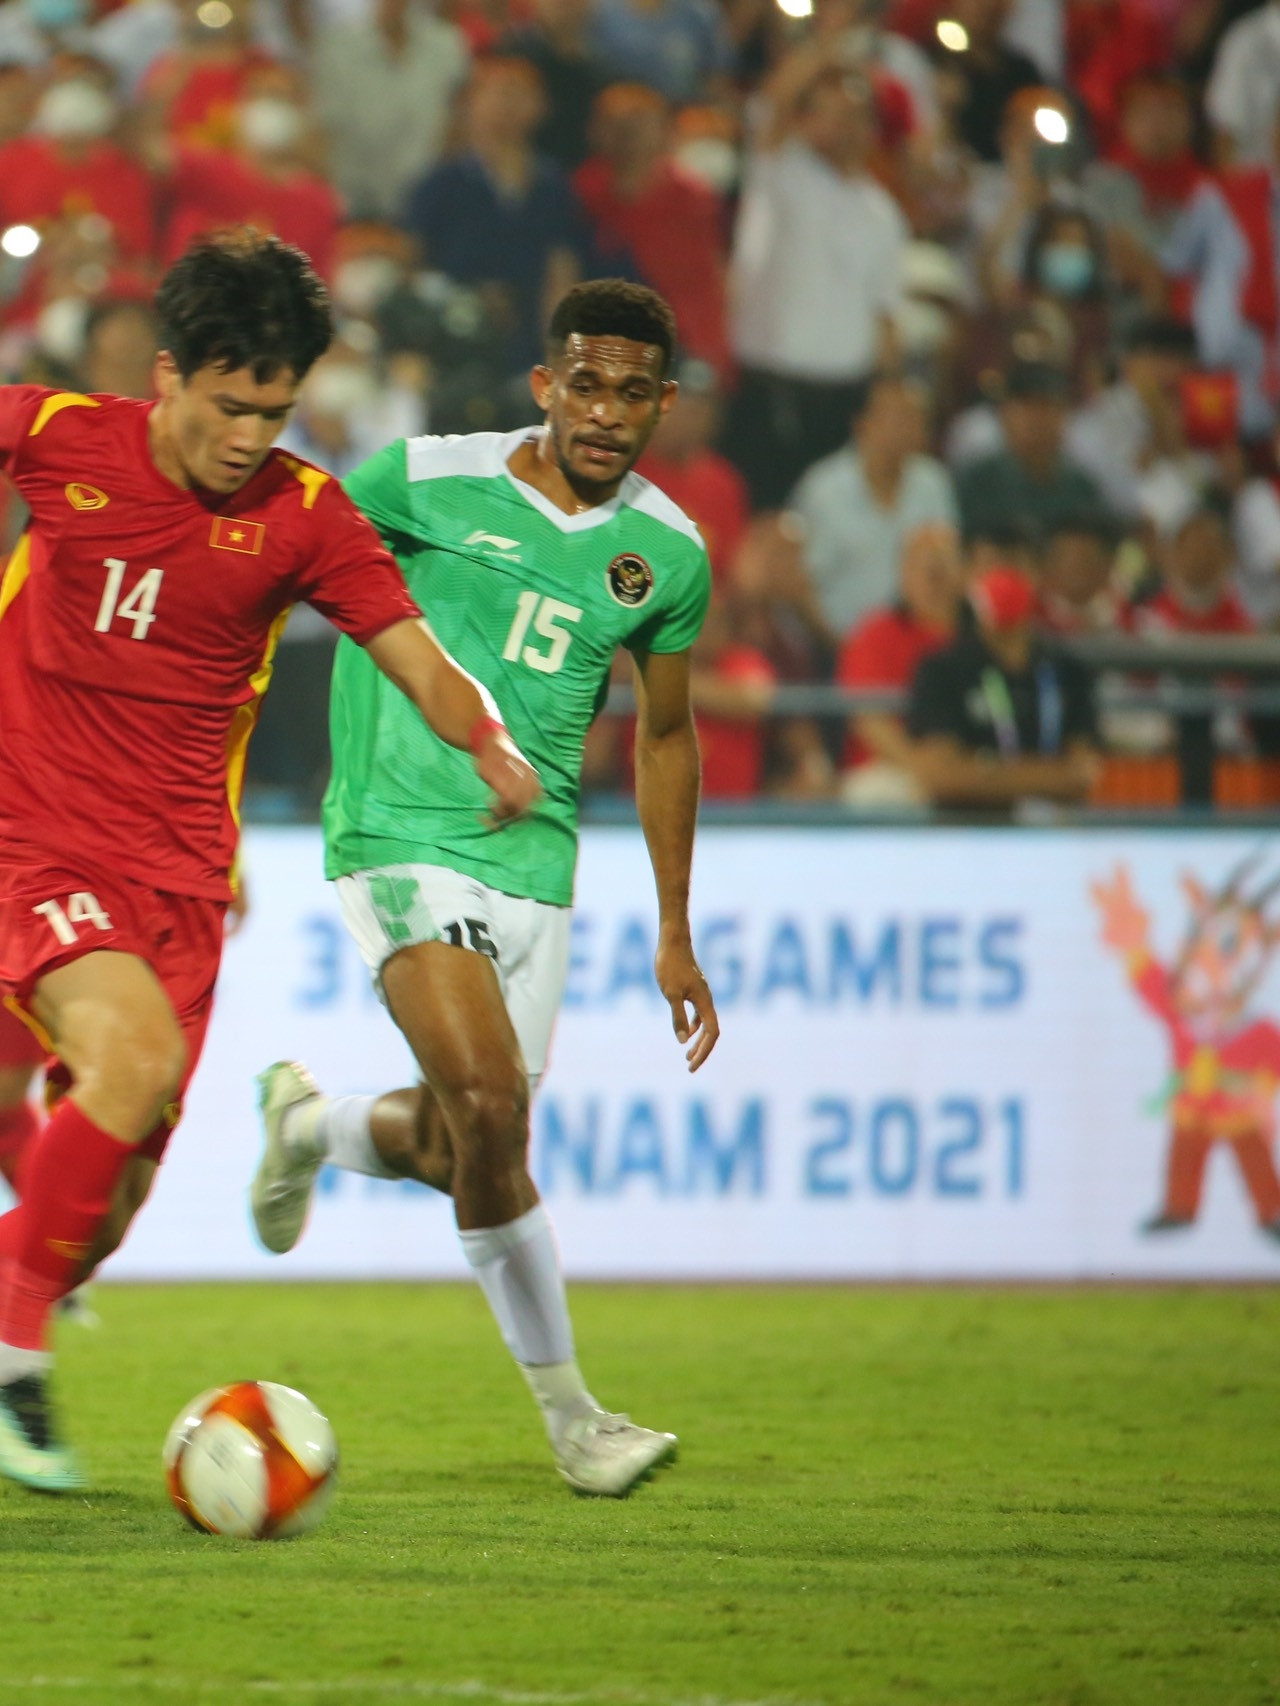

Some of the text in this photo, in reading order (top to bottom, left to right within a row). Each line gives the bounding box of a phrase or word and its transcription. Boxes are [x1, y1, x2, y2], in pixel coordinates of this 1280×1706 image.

[94, 557, 164, 640] 14
[502, 590, 584, 674] 15
[32, 892, 114, 945] 14
[443, 917, 499, 961] 15
[696, 914, 1032, 1012] GAMES
[804, 1096, 1032, 1202] 2021
